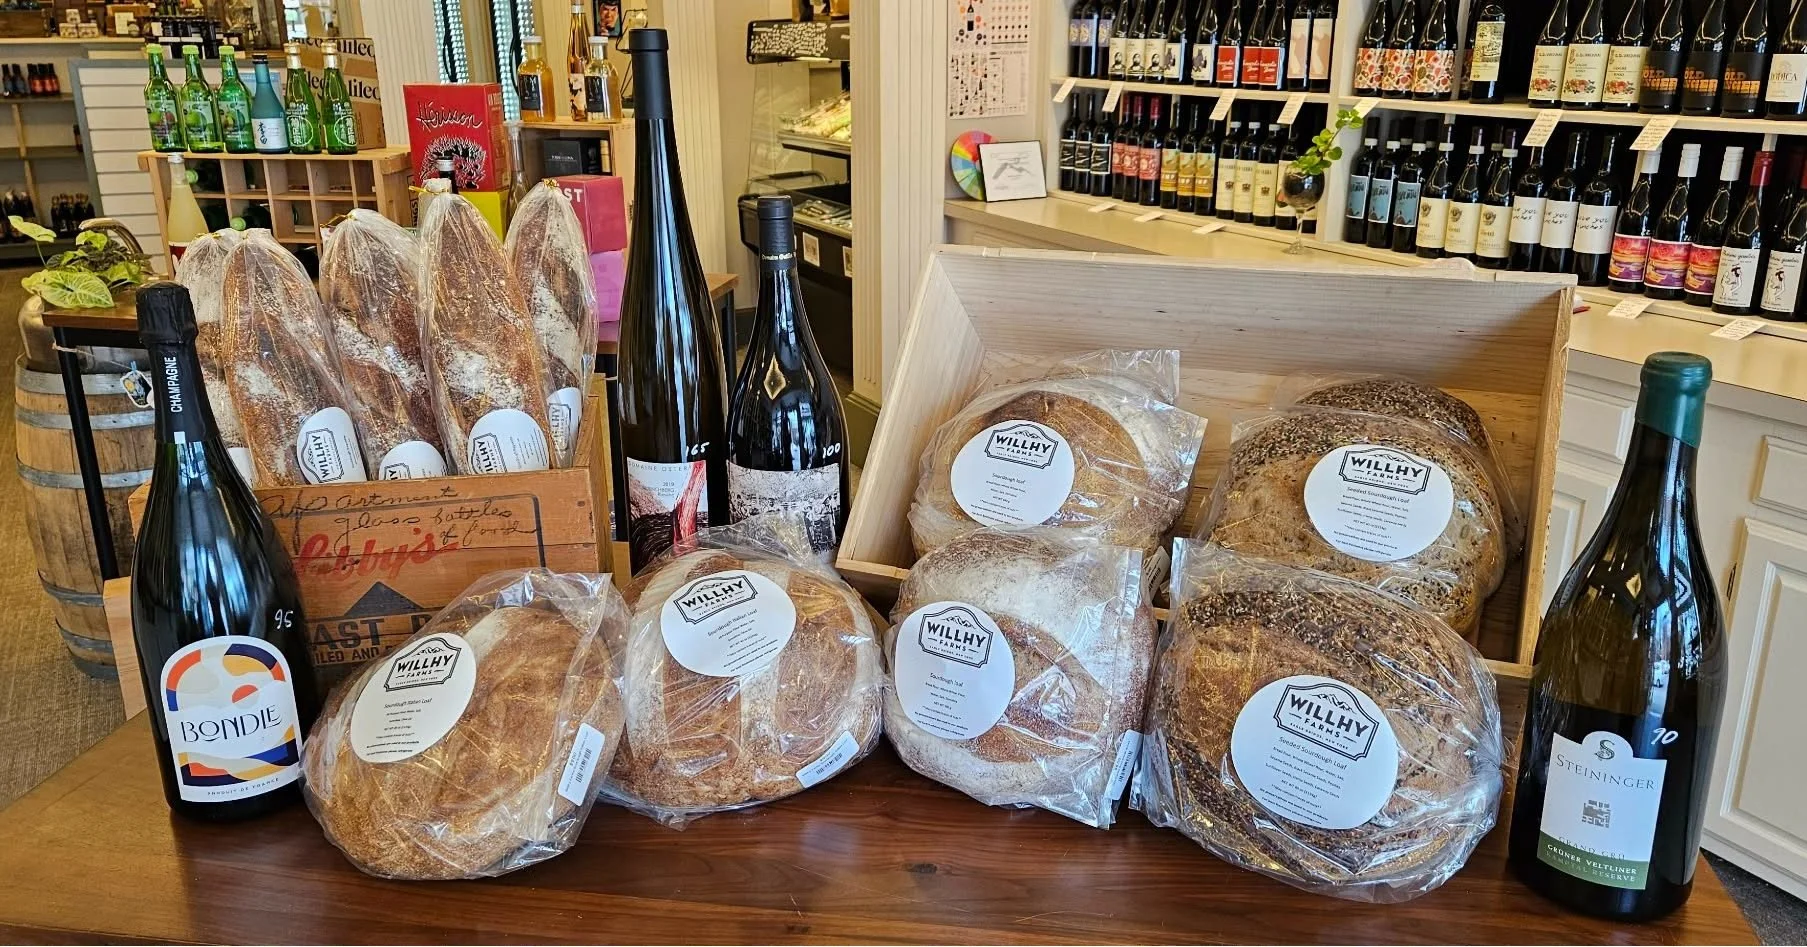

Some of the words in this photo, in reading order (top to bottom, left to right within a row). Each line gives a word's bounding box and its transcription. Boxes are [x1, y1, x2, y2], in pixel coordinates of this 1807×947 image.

[416, 100, 482, 132] Hérisson
[164, 357, 183, 413] CHAMPAGNE
[823, 443, 841, 458] 100
[996, 435, 1052, 454] WILLHY
[1007, 448, 1032, 457] FARMS
[312, 435, 330, 478] WILLHY
[477, 441, 494, 472] ILLHY
[1351, 457, 1424, 478] WILLHY
[1367, 471, 1400, 480] FARMS
[1347, 486, 1366, 494] Seeded
[1367, 489, 1396, 501] Sourdough
[682, 580, 743, 608] WILLHY
[705, 594, 733, 607] FARMS
[274, 609, 293, 629] 95
[313, 618, 384, 652] AST
[927, 622, 986, 648] WILLHY
[314, 650, 344, 666] ILED
[352, 646, 380, 661] AND
[940, 640, 966, 652] FARMS
[397, 654, 454, 672] WILLHY
[406, 670, 432, 678] FARMS
[1290, 693, 1369, 737] WILLHY
[1304, 719, 1340, 738] FARMS
[1651, 728, 1679, 745] 90
[1278, 736, 1301, 750] Seeded
[1299, 746, 1333, 765] Sourdough
[1332, 760, 1347, 770] Loaf
[1556, 754, 1654, 790] STEININGER
[1559, 836, 1596, 854] GRAND
[1547, 844, 1581, 863] GRÜNER
[1586, 859, 1636, 874] VELTLINER
[1592, 870, 1636, 882] RESERVE
